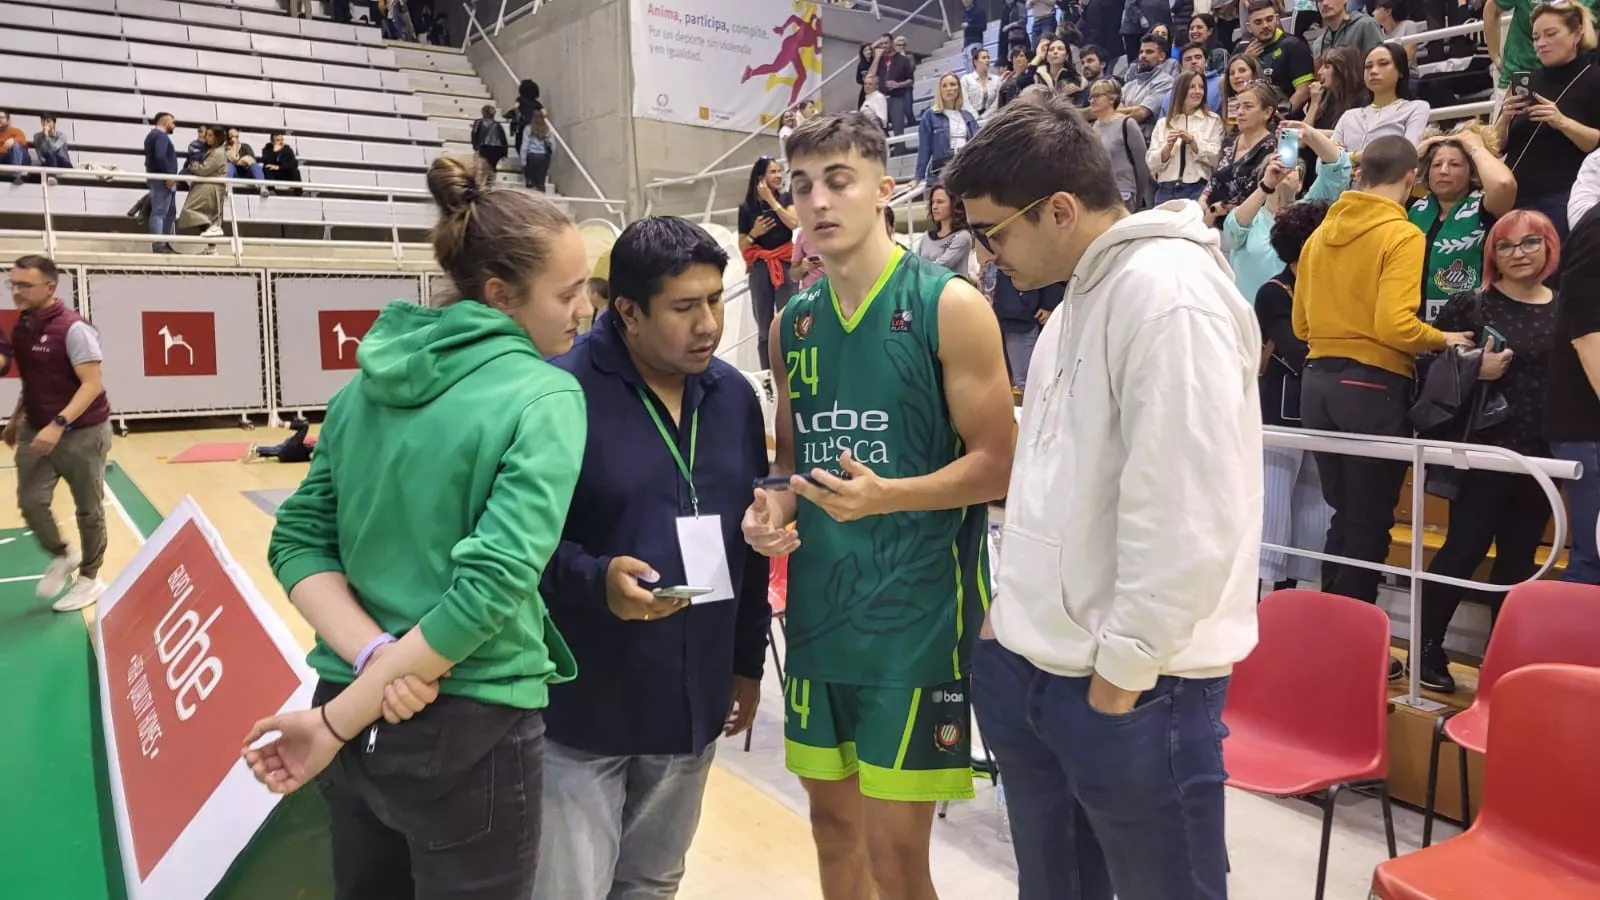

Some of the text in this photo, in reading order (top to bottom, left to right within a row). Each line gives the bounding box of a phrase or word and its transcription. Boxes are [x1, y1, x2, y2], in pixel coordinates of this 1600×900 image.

[647, 3, 770, 40] Anima, participa, compite.
[648, 25, 752, 55] Por un deporte sin violencia
[786, 346, 819, 399] 24
[167, 564, 191, 599] GRUPO
[127, 673, 154, 721] QUALITY
